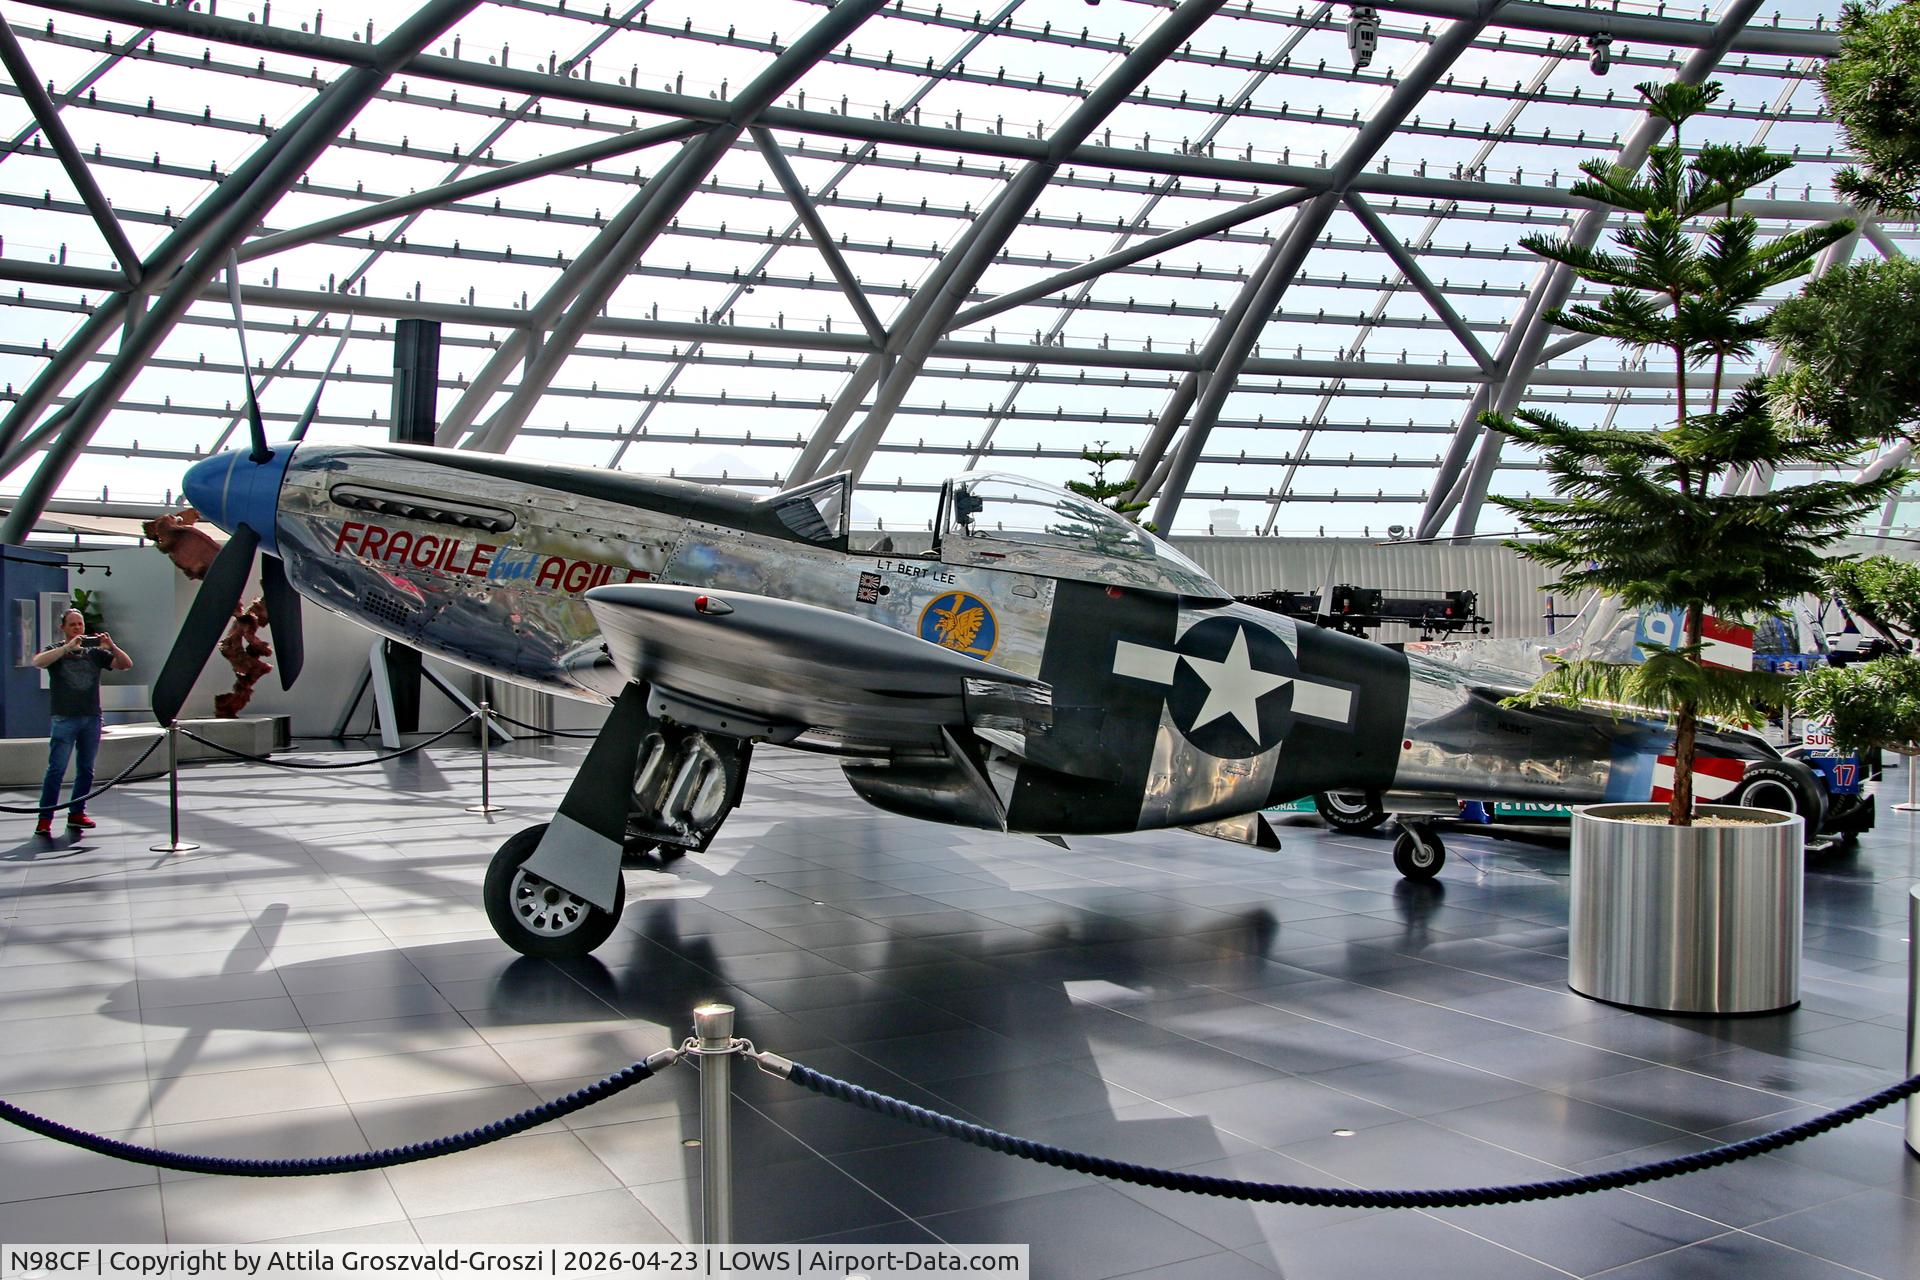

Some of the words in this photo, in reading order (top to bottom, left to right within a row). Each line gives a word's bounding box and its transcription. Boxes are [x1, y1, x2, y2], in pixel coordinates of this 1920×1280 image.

[335, 521, 497, 576] FRAGILE
[488, 540, 540, 581] but
[877, 559, 892, 571] LT
[898, 564, 928, 578] BERT
[933, 571, 956, 585] LEE
[1833, 765, 1855, 786] 17
